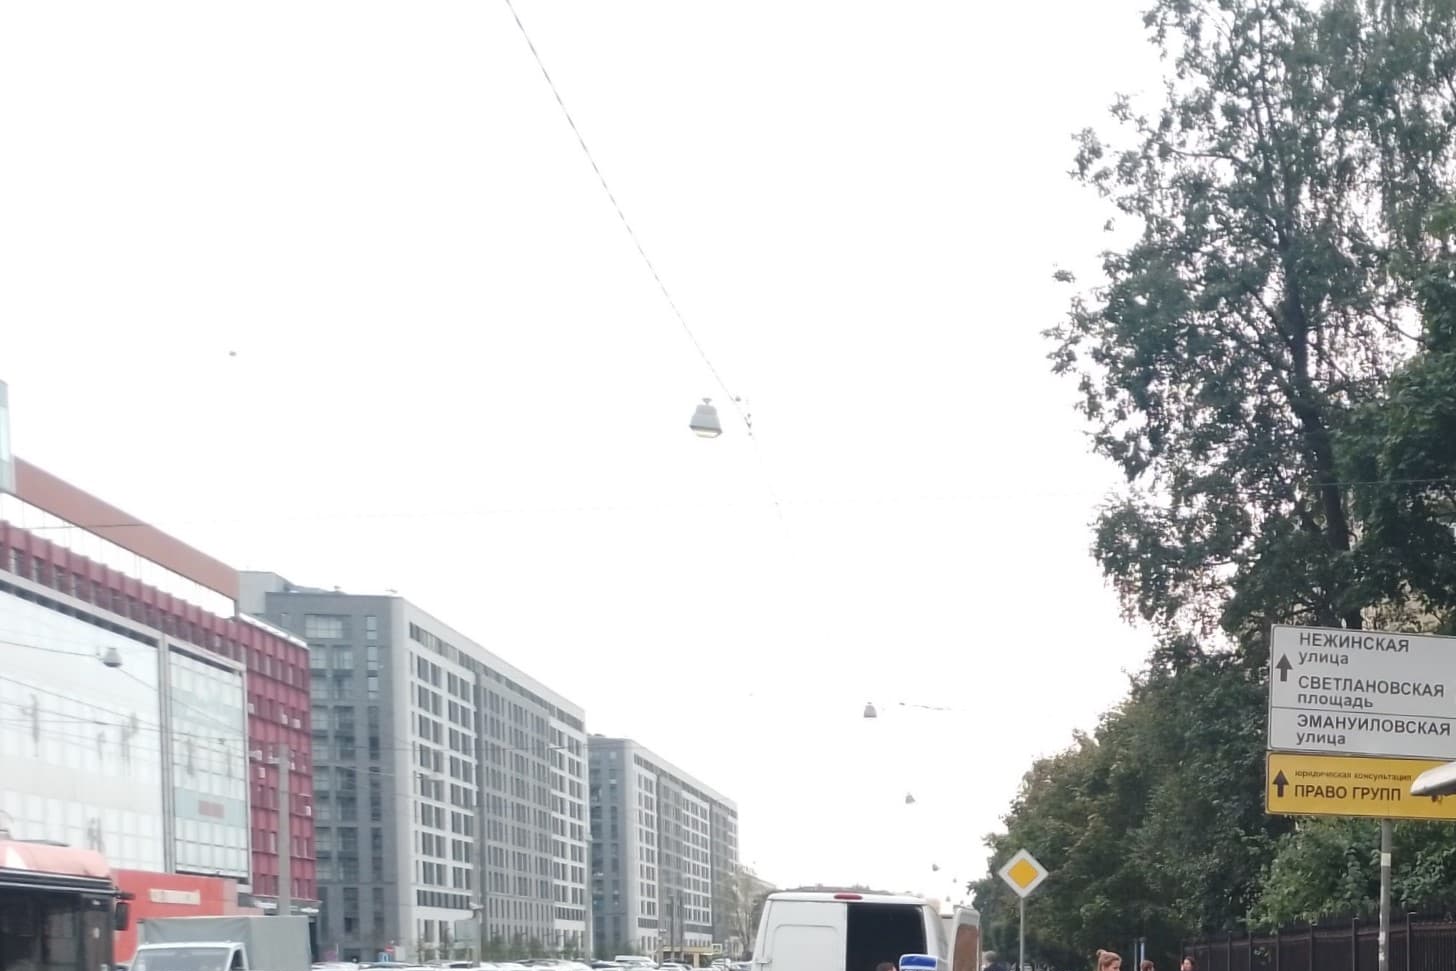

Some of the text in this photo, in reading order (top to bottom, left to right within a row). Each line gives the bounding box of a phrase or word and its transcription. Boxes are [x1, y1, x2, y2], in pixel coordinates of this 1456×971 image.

[1300, 632, 1409, 652] НЕЖИНСКАЯ
[1299, 651, 1349, 665] улица
[1298, 675, 1444, 697] СВЕТЛАНОВСКАЯ
[1297, 693, 1373, 709] площадь
[1297, 714, 1450, 736] ЭМАНУИЛОВСКАЯ
[1296, 731, 1346, 746] улица
[1295, 770, 1412, 783] юридическая консультация
[1295, 784, 1401, 801] ПРАВО ГРУПП
